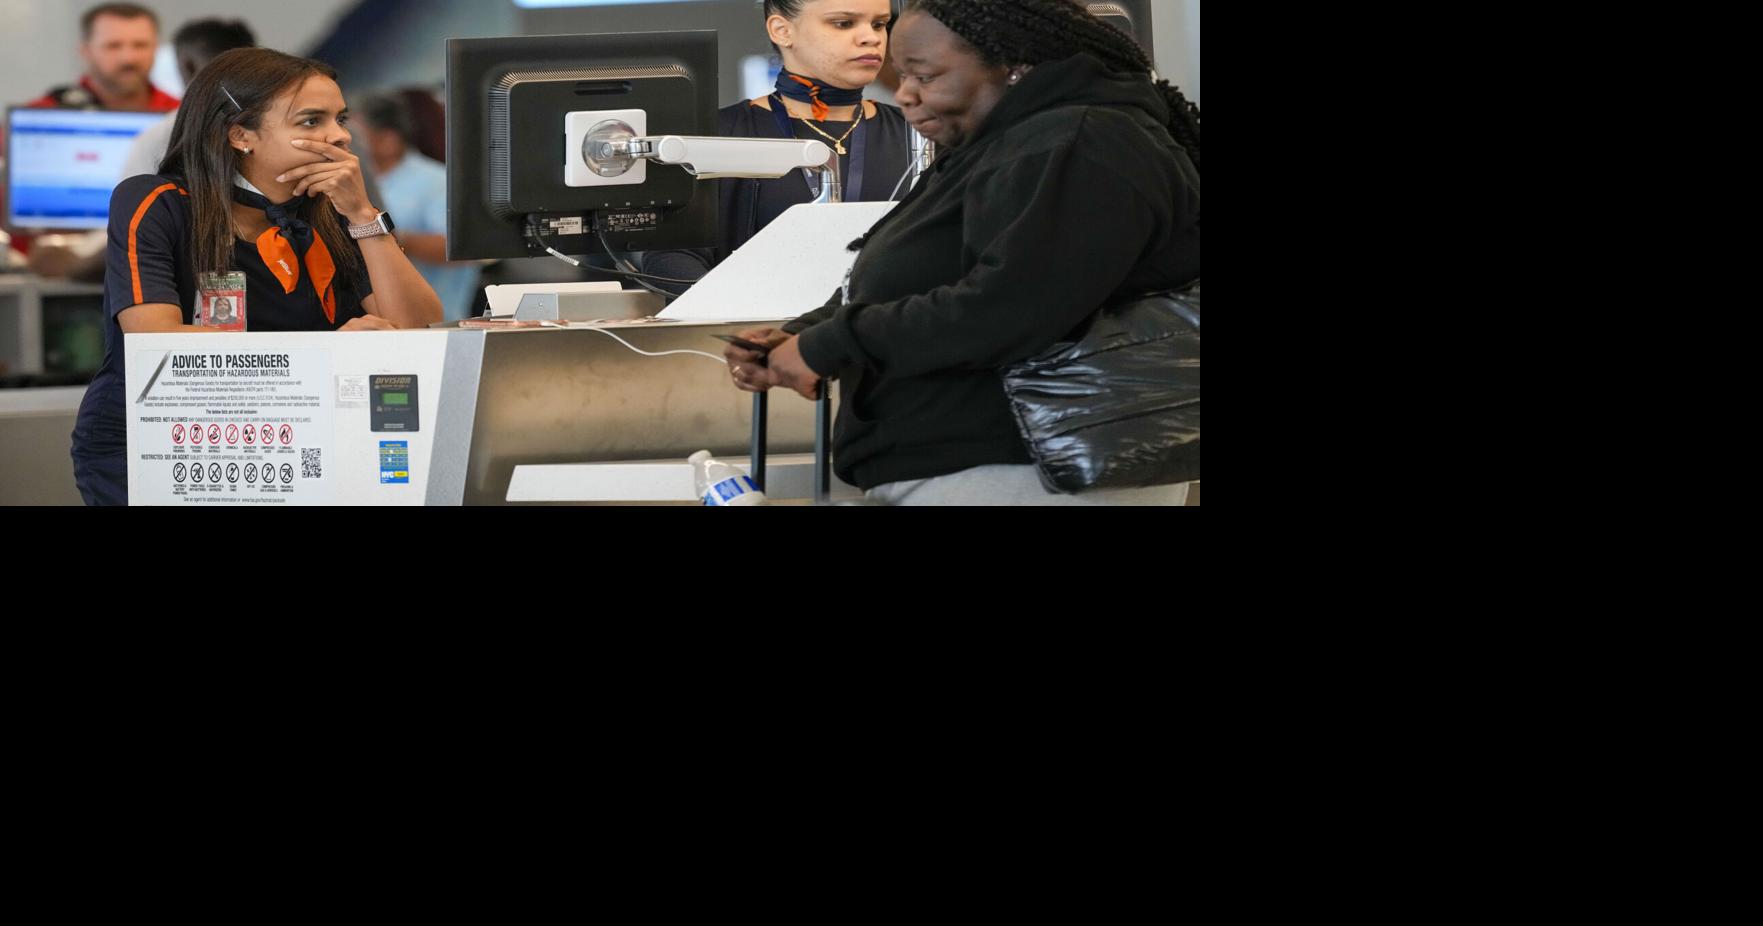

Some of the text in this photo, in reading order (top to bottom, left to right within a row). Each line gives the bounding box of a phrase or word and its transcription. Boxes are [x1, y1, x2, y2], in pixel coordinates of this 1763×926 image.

[172, 354, 290, 368] ADVICE TO PASSENGERS
